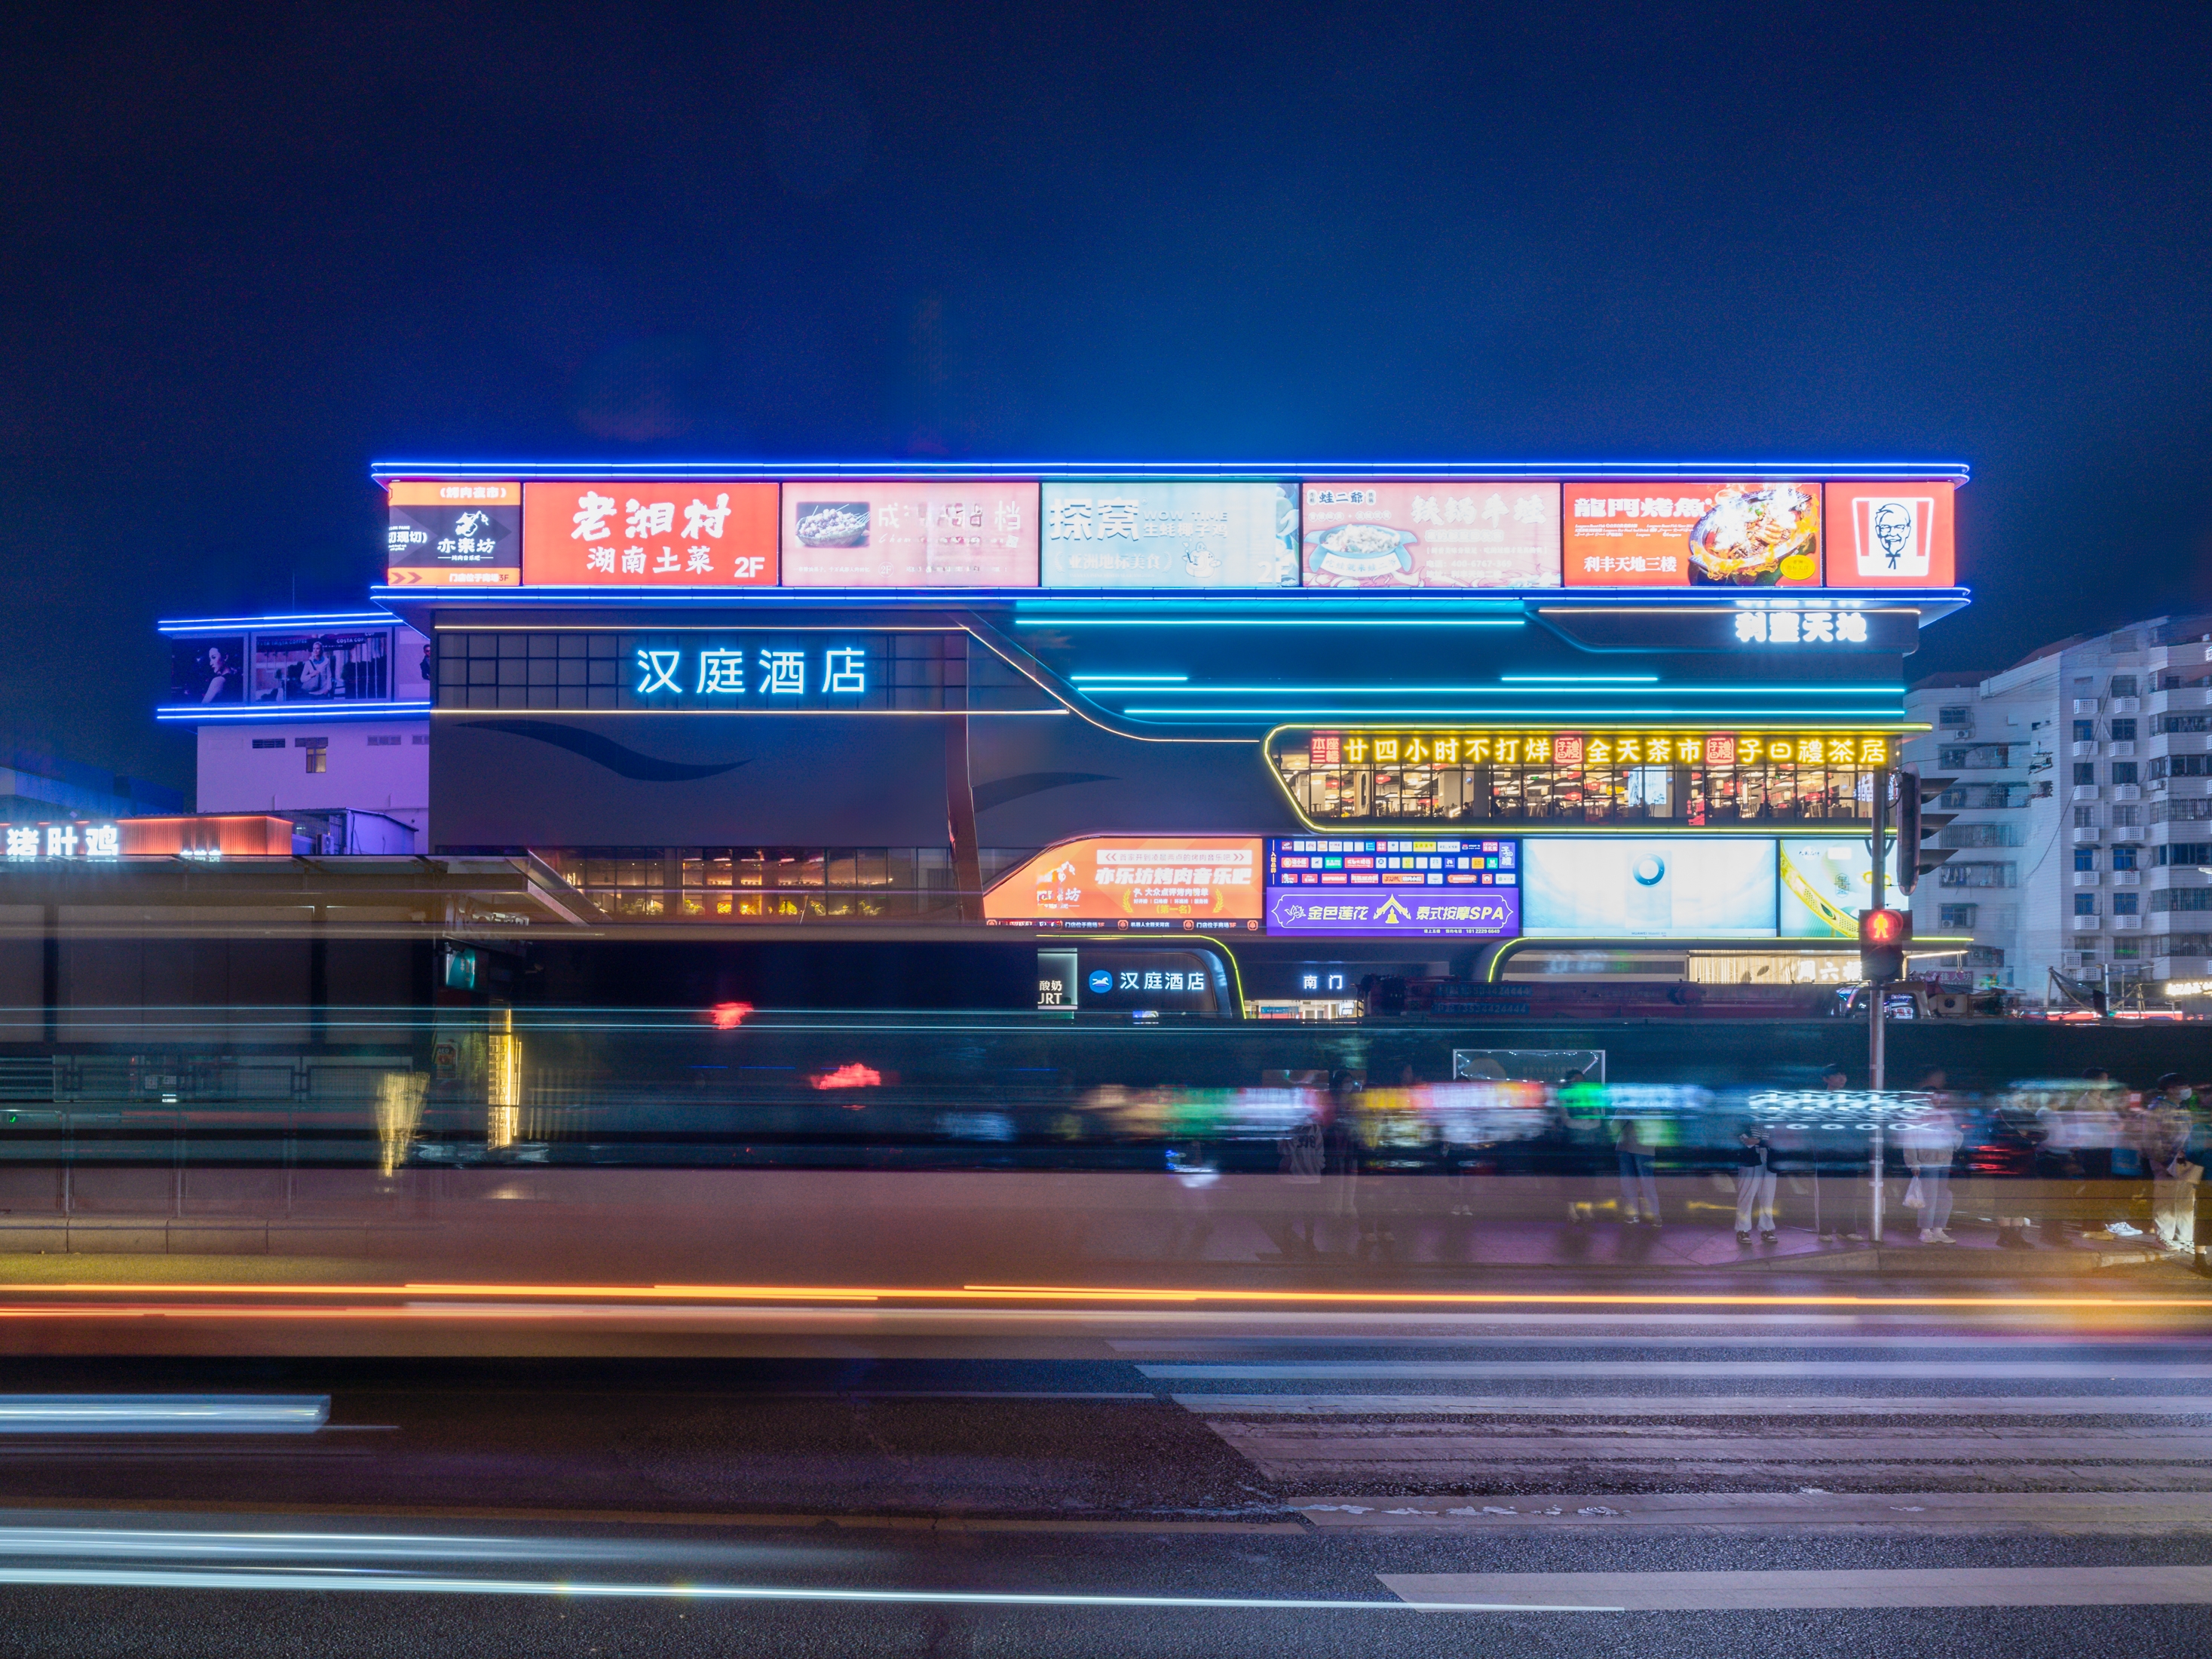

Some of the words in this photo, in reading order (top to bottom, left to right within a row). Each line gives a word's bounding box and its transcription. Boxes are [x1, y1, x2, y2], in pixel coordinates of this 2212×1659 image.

[571, 491, 731, 541] 老湘村
[1143, 511, 1184, 521] WOW
[1192, 511, 1227, 521] TIME
[1411, 493, 1546, 529] 铁锅牛蛙
[1574, 498, 1706, 517] 龍門烤魚
[1049, 497, 1139, 541] 探窝
[1143, 523, 1228, 538] 生蚝椰子鸡
[586, 545, 714, 575] 湖南土菜
[734, 557, 764, 578] 2F
[1068, 553, 1162, 570] 亚洲地标美食
[1584, 556, 1677, 573] 利丰天地三楼
[1258, 560, 1290, 584] 2F
[638, 647, 864, 694] 汉庭酒店
[1344, 738, 1551, 762] 廿四小时不打烊
[1586, 739, 1701, 762] 全天茶市
[1095, 867, 1252, 885] 亦乐坊烤肉音乐吧
[1307, 906, 1368, 920] 金色莲花
[1416, 906, 1504, 920] 泰式按摩SPA
[1039, 980, 1062, 992] 酸奶
[1120, 971, 1204, 990] 汉庭酒店
[1304, 975, 1343, 989] 南门
[1037, 992, 1062, 1004] JRT
